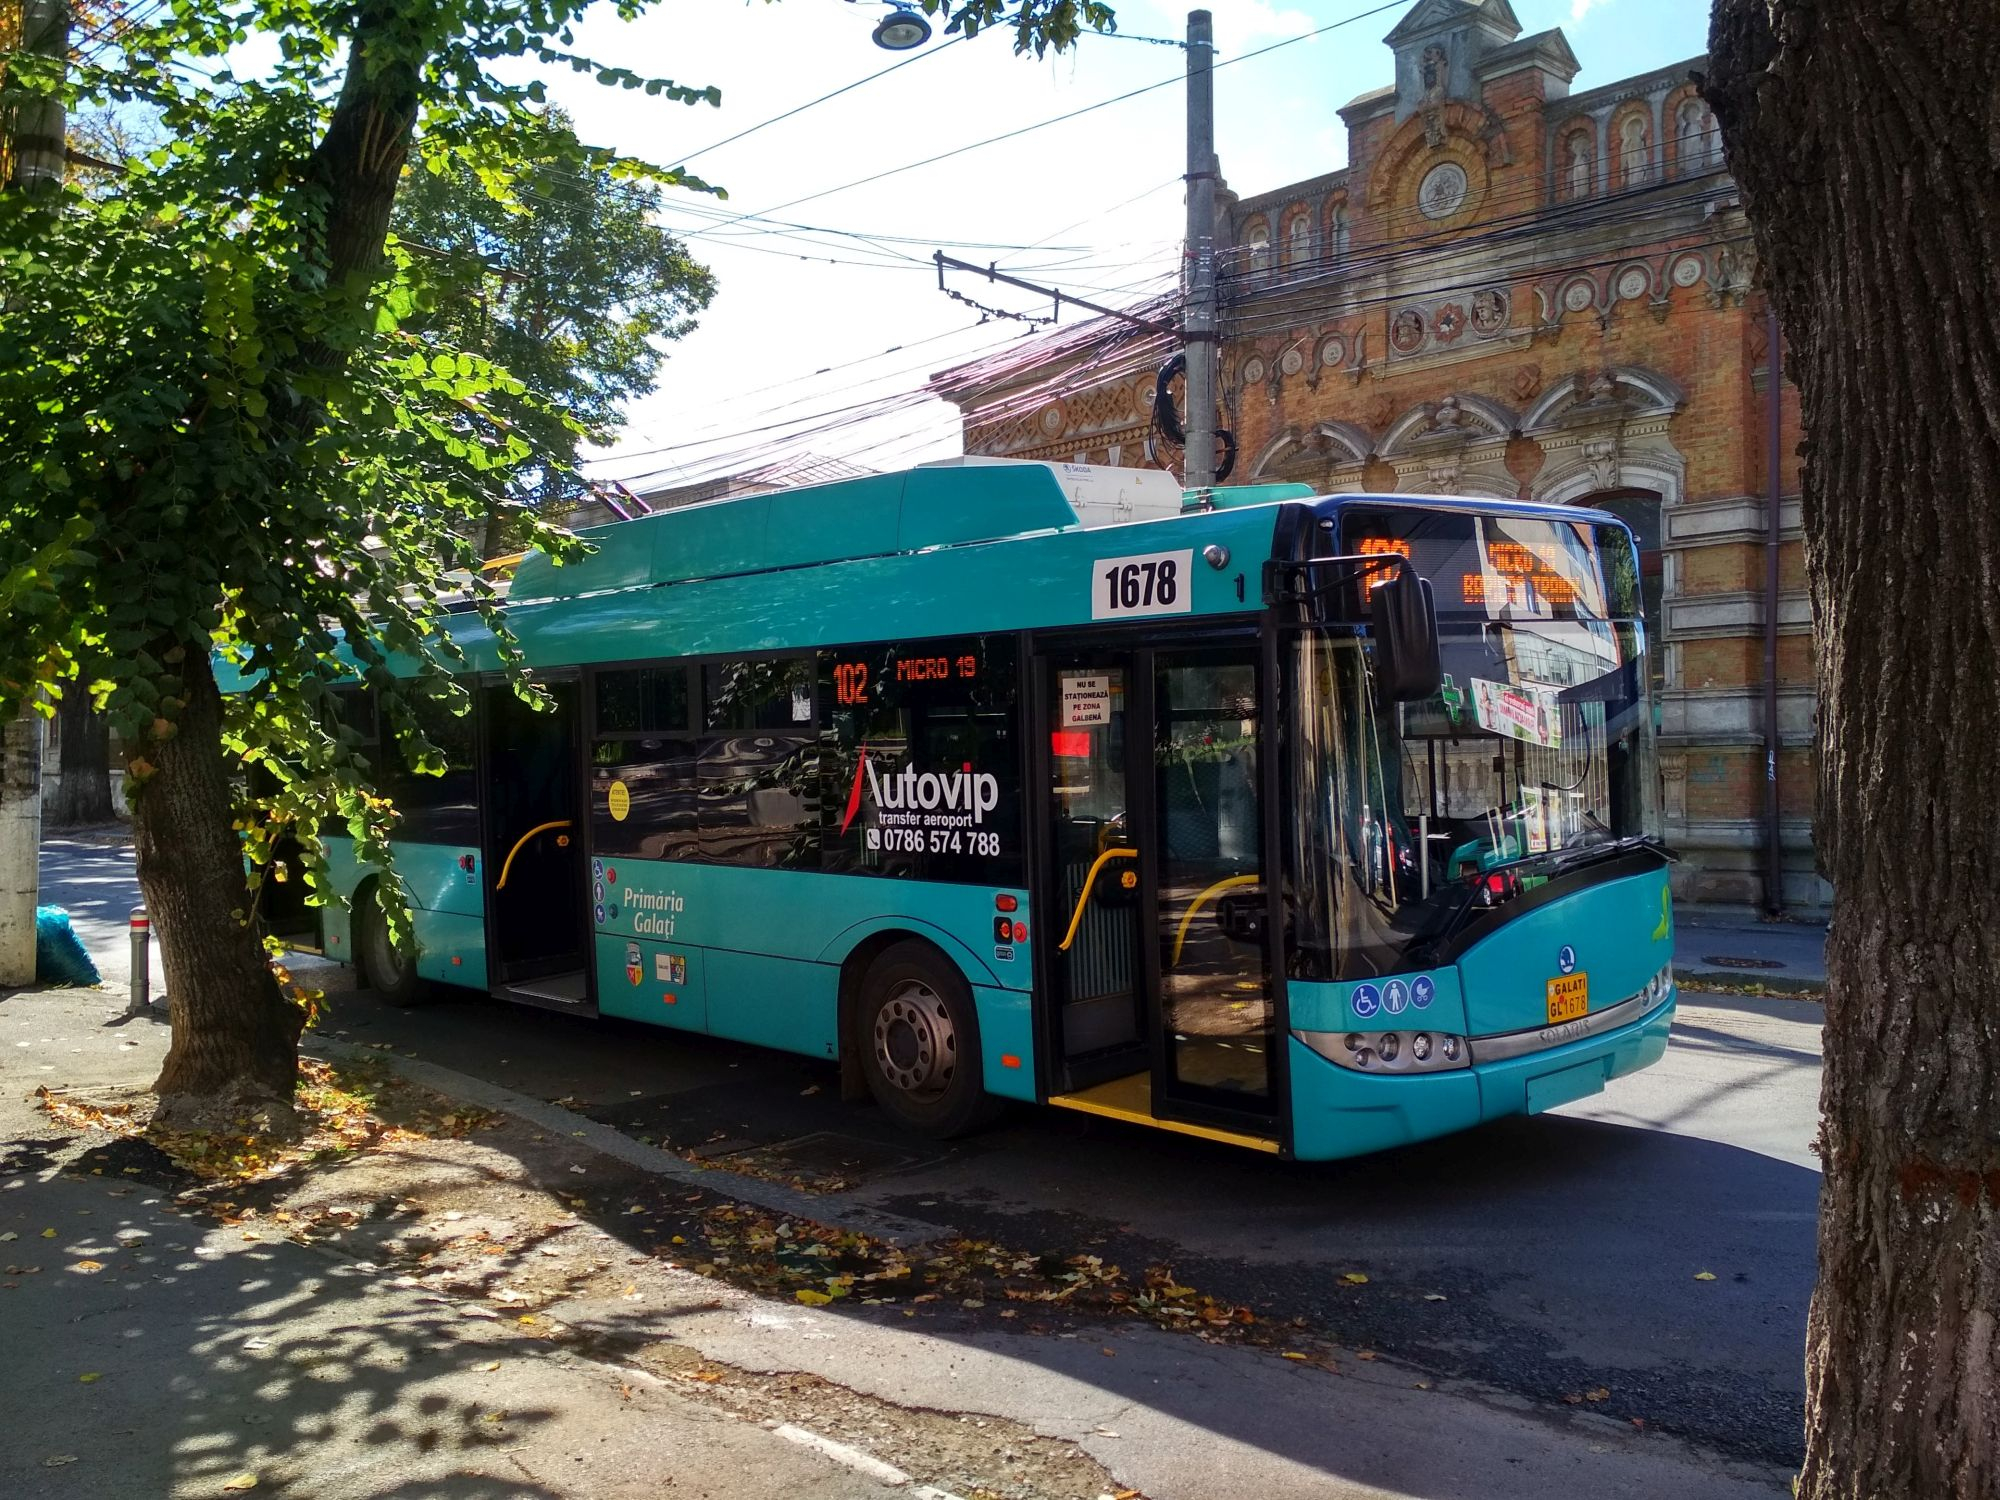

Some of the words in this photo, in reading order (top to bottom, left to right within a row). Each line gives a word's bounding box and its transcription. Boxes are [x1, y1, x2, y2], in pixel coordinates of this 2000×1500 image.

[1105, 560, 1177, 609] 1678
[833, 662, 869, 704] 102
[896, 657, 949, 681] MICRO
[955, 655, 977, 678] 19
[1076, 681, 1087, 689] NU
[1087, 680, 1097, 688] SE
[1073, 703, 1082, 711] PE
[1083, 703, 1101, 711] ZONA
[841, 742, 999, 836] Autovip
[878, 810, 922, 826] transfer
[923, 812, 973, 830] aeroport
[884, 828, 925, 853] 0786
[929, 830, 962, 855] 574
[966, 831, 1000, 857] 788
[623, 887, 685, 913] Primăria
[1555, 978, 1586, 996] GALATI
[1550, 1001, 1563, 1018] GL
[1563, 995, 1586, 1015] 1678
[1539, 1019, 1591, 1045] SOLARIS
